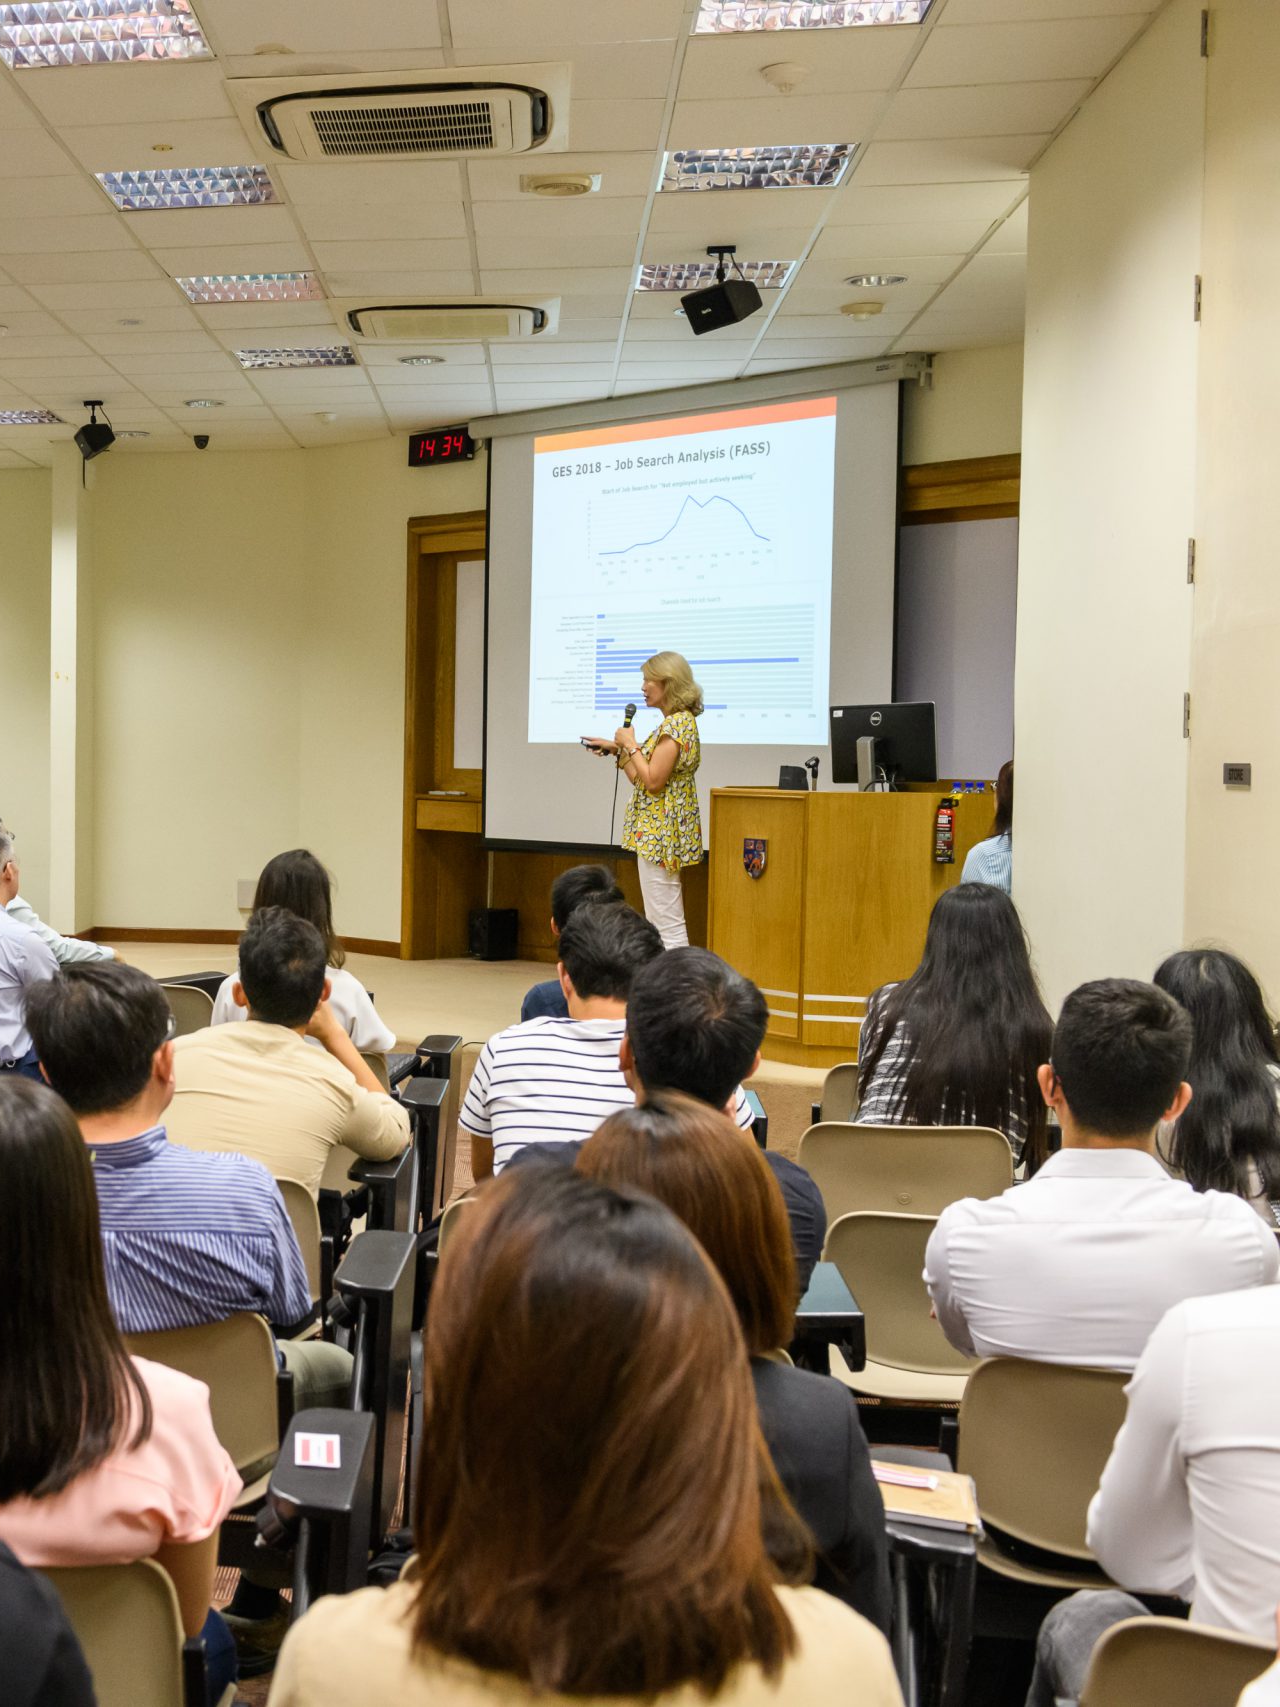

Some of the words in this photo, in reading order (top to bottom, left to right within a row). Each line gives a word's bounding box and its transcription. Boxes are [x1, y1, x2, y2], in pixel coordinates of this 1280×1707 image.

[419, 439, 436, 459] 14
[441, 435, 463, 457] 34
[552, 465, 573, 478] GES
[576, 461, 602, 476] 2018
[615, 457, 634, 471] Job
[636, 452, 674, 469] Search
[677, 446, 726, 464] Analysis
[729, 440, 771, 461] (FASS)
[1228, 768, 1244, 781] STORE
